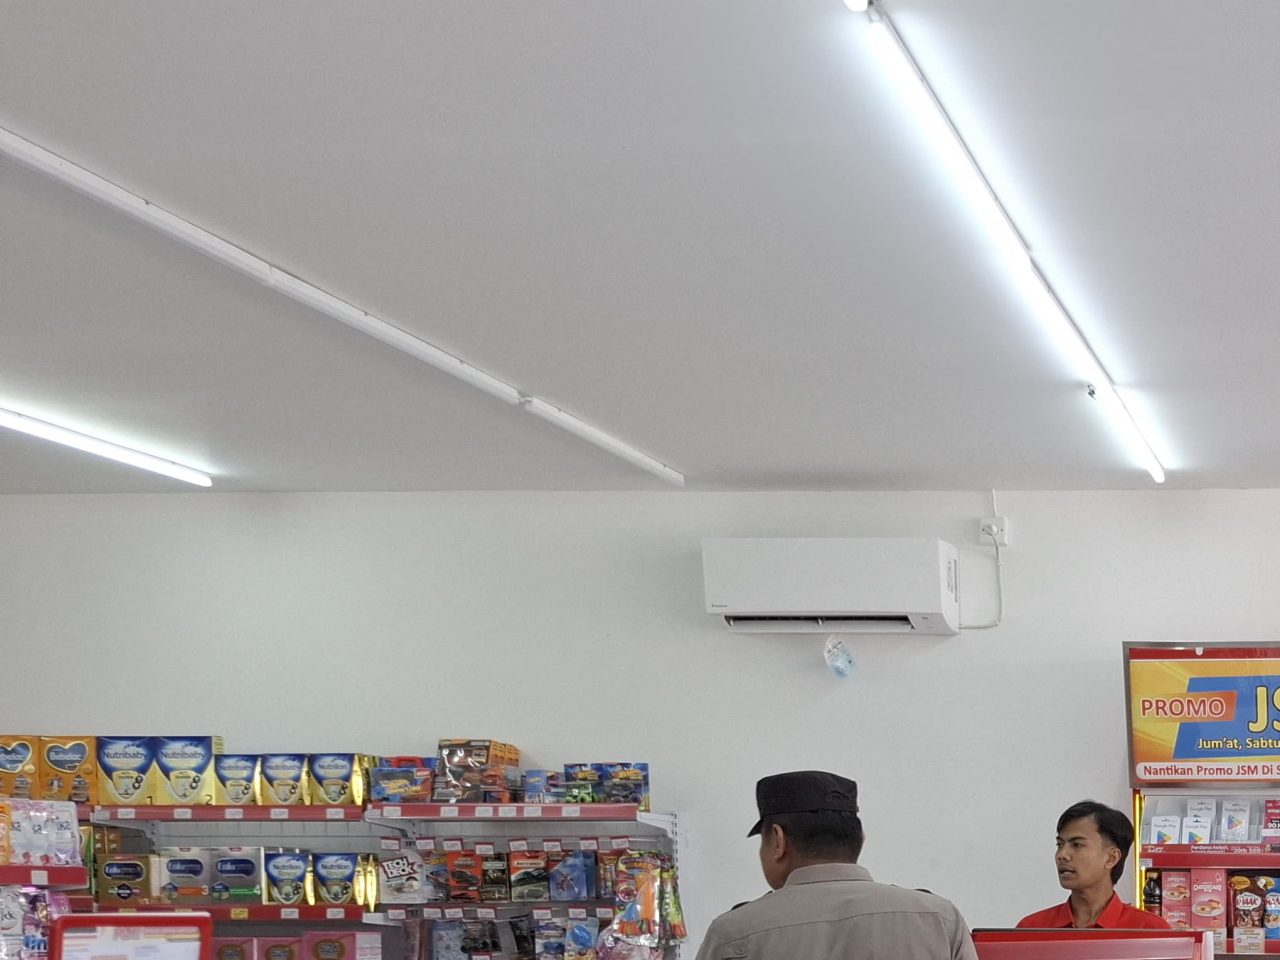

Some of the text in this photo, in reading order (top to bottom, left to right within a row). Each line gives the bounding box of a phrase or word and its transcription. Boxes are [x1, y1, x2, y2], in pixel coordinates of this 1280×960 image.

[1141, 697, 1226, 718] PROMO
[1198, 737, 1243, 751] Jum'at,
[1143, 765, 1193, 776] Nantikan
[1196, 765, 1233, 776] Promo
[1235, 765, 1258, 776] JSM
[1261, 765, 1273, 776] Di
[383, 857, 407, 868] TECH
[387, 865, 417, 877] DECK
